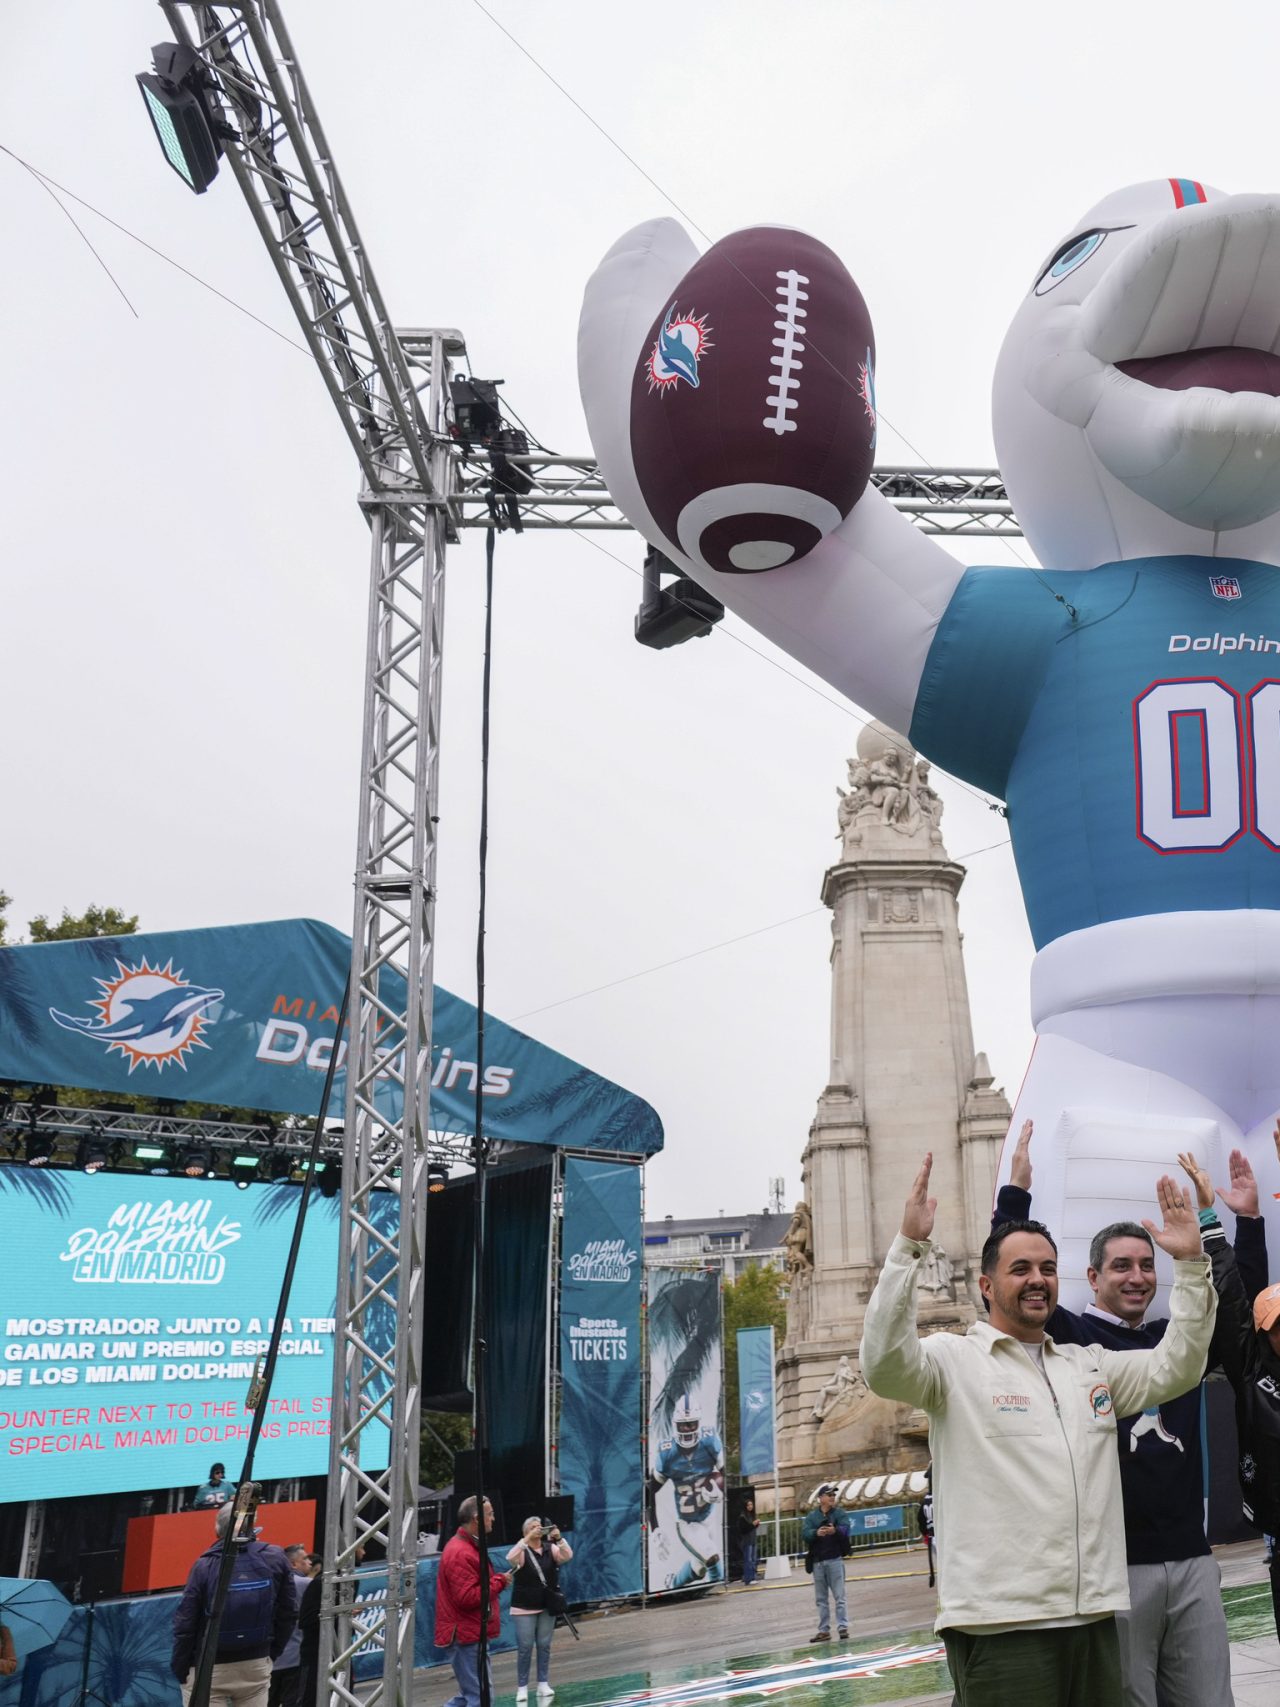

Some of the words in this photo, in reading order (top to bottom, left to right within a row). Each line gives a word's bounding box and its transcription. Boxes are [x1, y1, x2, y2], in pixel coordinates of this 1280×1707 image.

[1215, 585, 1238, 597] NFL
[272, 995, 385, 1032] MIAI
[108, 1199, 212, 1230] MIAMI
[59, 1215, 242, 1261] DOLPHINS
[585, 1239, 625, 1254] MIAMI
[74, 1251, 116, 1281] EN
[118, 1251, 224, 1283] MADRID
[567, 1248, 637, 1271] DOLPHINS
[590, 1265, 630, 1281] MADRID
[6, 1318, 160, 1336] MOSTRADOR
[166, 1318, 241, 1334] JUNTO
[246, 1318, 262, 1333] A
[570, 1326, 627, 1337] Illustrated
[579, 1318, 618, 1329] Sports
[5, 1343, 95, 1361] GANAR
[102, 1342, 137, 1358] UN
[143, 1340, 225, 1357] PREMIO
[570, 1339, 627, 1360] TICKETS
[29, 1367, 78, 1385] LOS
[85, 1364, 156, 1383] MIAMI
[98, 1405, 157, 1424] NEXT
[166, 1403, 192, 1420] TO
[201, 1401, 237, 1418] THE
[9, 1433, 106, 1455] SPECIAL
[114, 1428, 178, 1448] MIAMI
[184, 1423, 281, 1443] DOLPHNS
